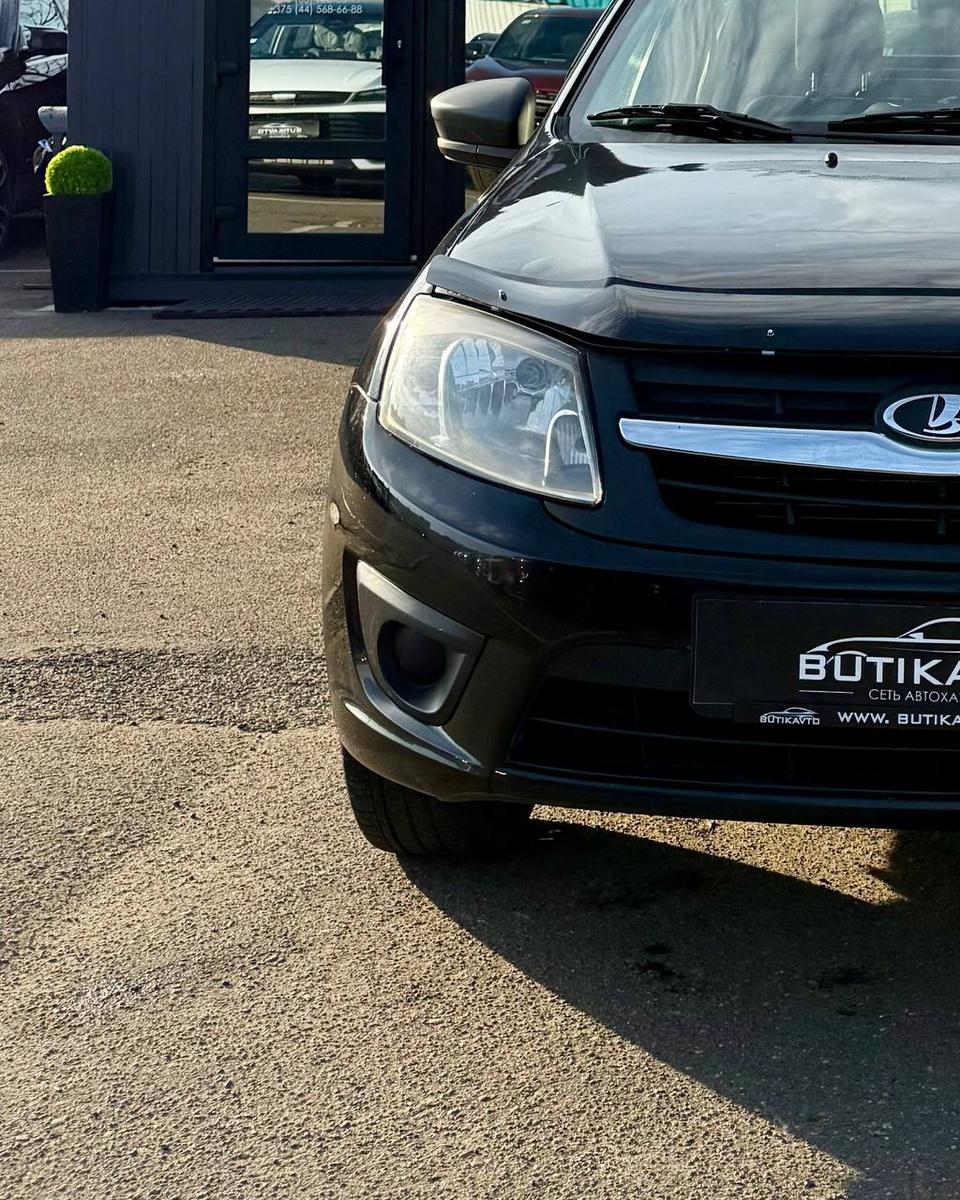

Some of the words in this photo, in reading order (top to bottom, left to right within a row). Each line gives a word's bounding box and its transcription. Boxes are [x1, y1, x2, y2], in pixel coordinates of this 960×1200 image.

[295, 3, 313, 15] (44)
[316, 4, 363, 14] 568-66-88
[868, 688, 901, 702] СЕТЬ
[760, 714, 820, 725] BUTIKAVTO
